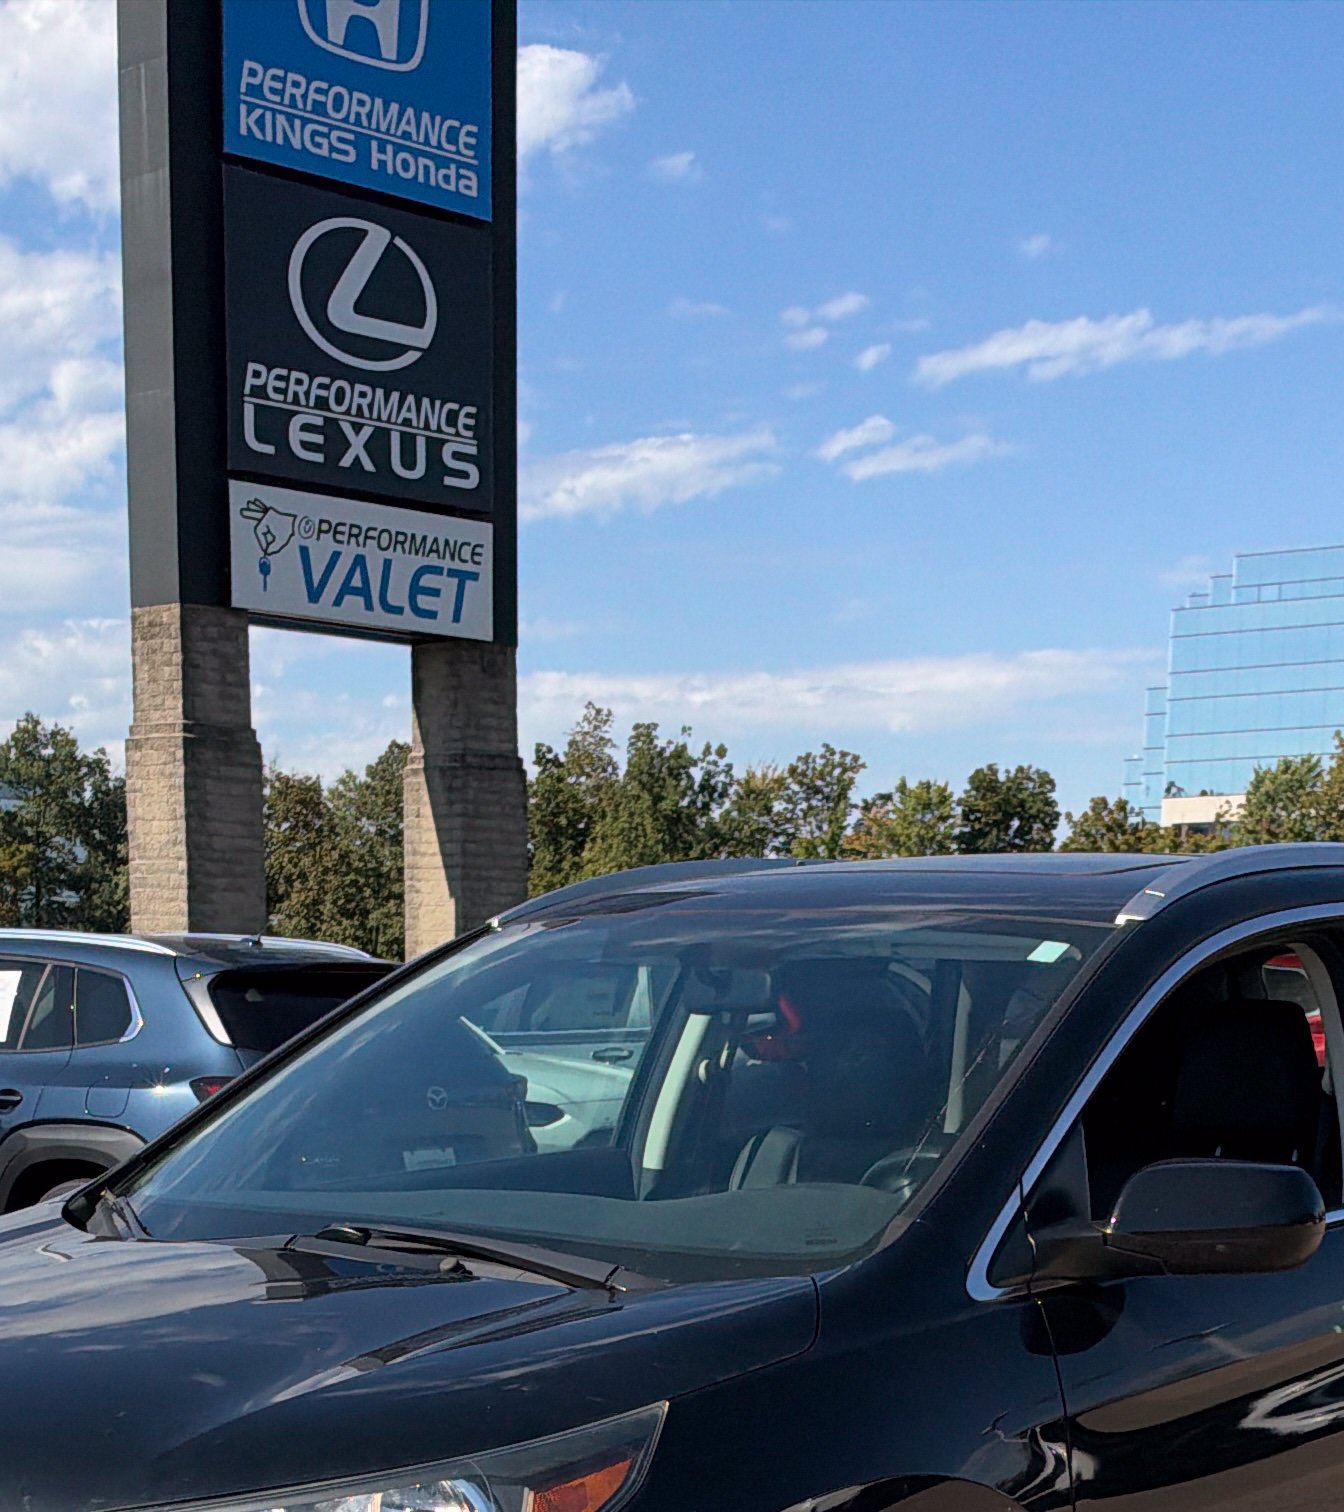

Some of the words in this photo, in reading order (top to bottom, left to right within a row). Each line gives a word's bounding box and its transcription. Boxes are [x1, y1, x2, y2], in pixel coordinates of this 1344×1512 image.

[240, 59, 479, 158] PERFORMANCE
[239, 103, 356, 164] KINGS
[370, 139, 479, 198] Honda
[243, 361, 478, 438] PERFORMANCE
[243, 403, 481, 490] LEXUS
[316, 518, 484, 566] PERFORMANCE
[298, 544, 480, 624] VALET
